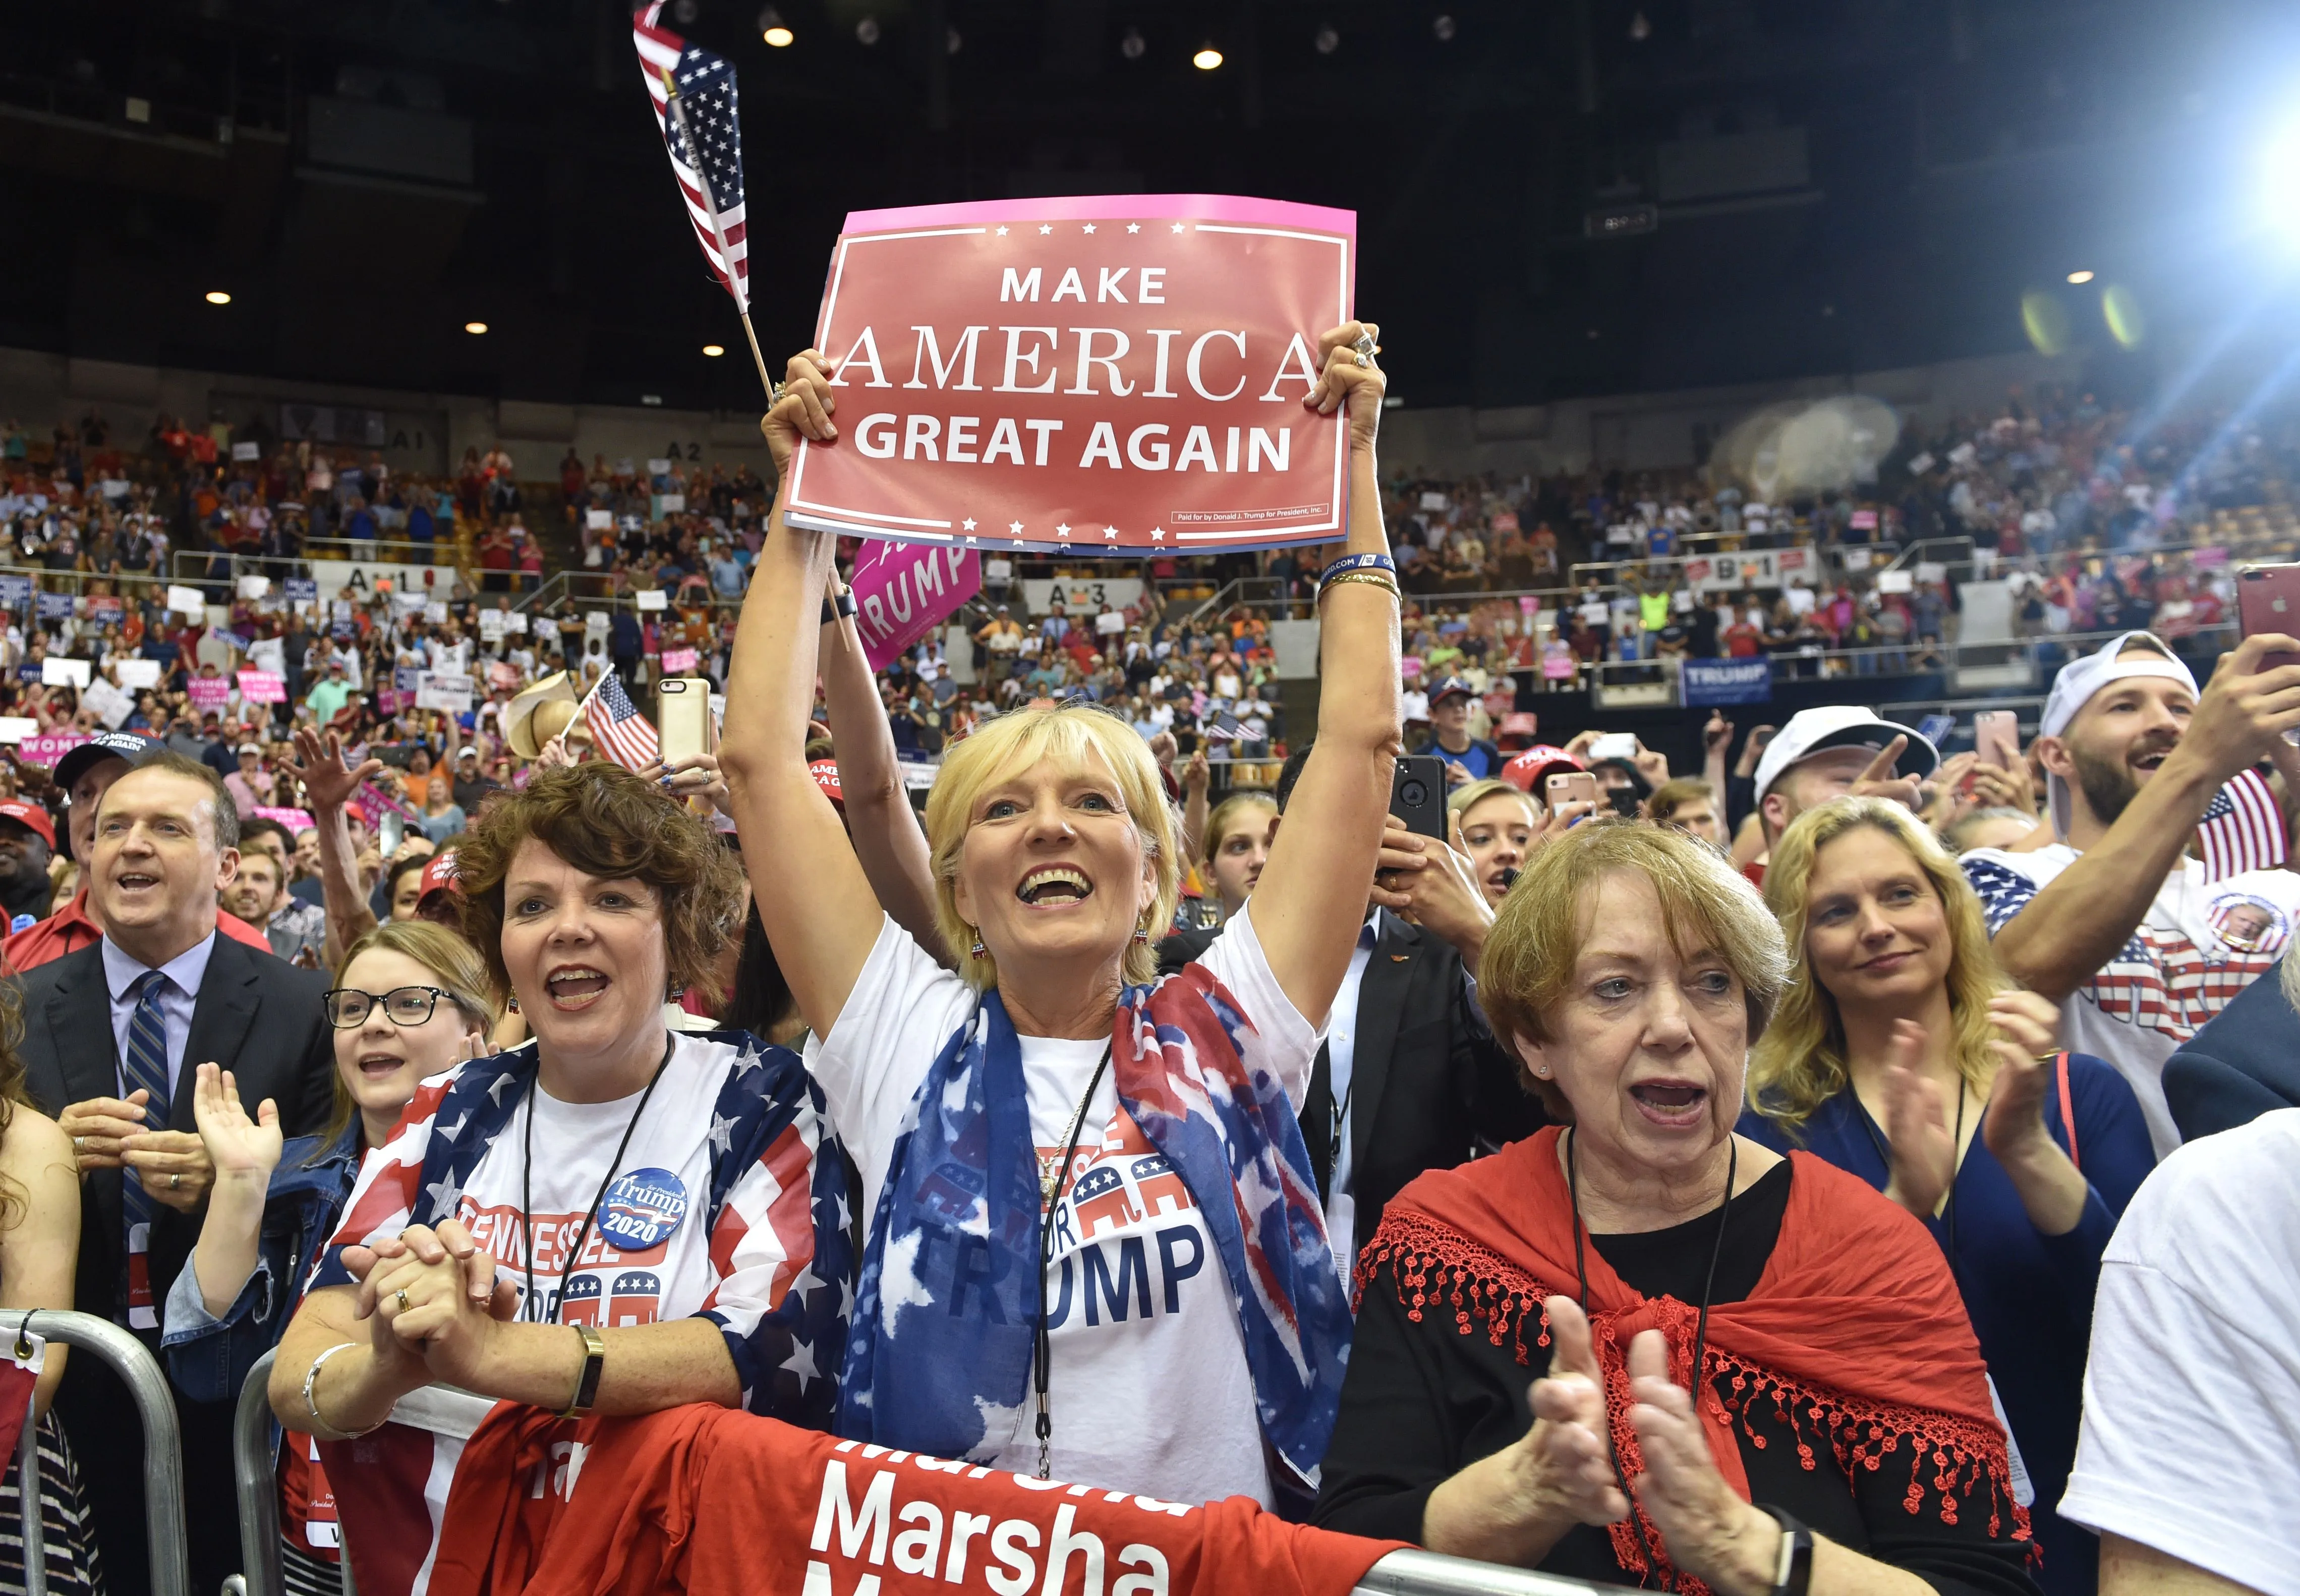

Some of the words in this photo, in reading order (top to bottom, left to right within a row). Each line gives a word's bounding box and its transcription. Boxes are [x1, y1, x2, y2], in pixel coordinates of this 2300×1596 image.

[999, 267, 1167, 304] MAKE
[831, 325, 1318, 402] AMERICA
[854, 413, 1064, 466] GREAT
[1078, 422, 1291, 473] AGAIN
[1204, 514, 1212, 522] by
[1244, 512, 1265, 521] Trump
[1277, 508, 1309, 517] President,
[348, 568, 368, 591] A
[854, 547, 966, 649] TRUMP
[1050, 584, 1066, 605] A
[1092, 584, 1105, 604] 3
[1686, 664, 1767, 685] TRUMP
[21, 738, 92, 753] WOME
[102, 733, 147, 747] AMERICA
[107, 739, 141, 752] AGAIN
[614, 1177, 685, 1217] Trump
[657, 1187, 683, 1200] President
[603, 1212, 659, 1242] 2020
[810, 1459, 1169, 1596] Marsha
